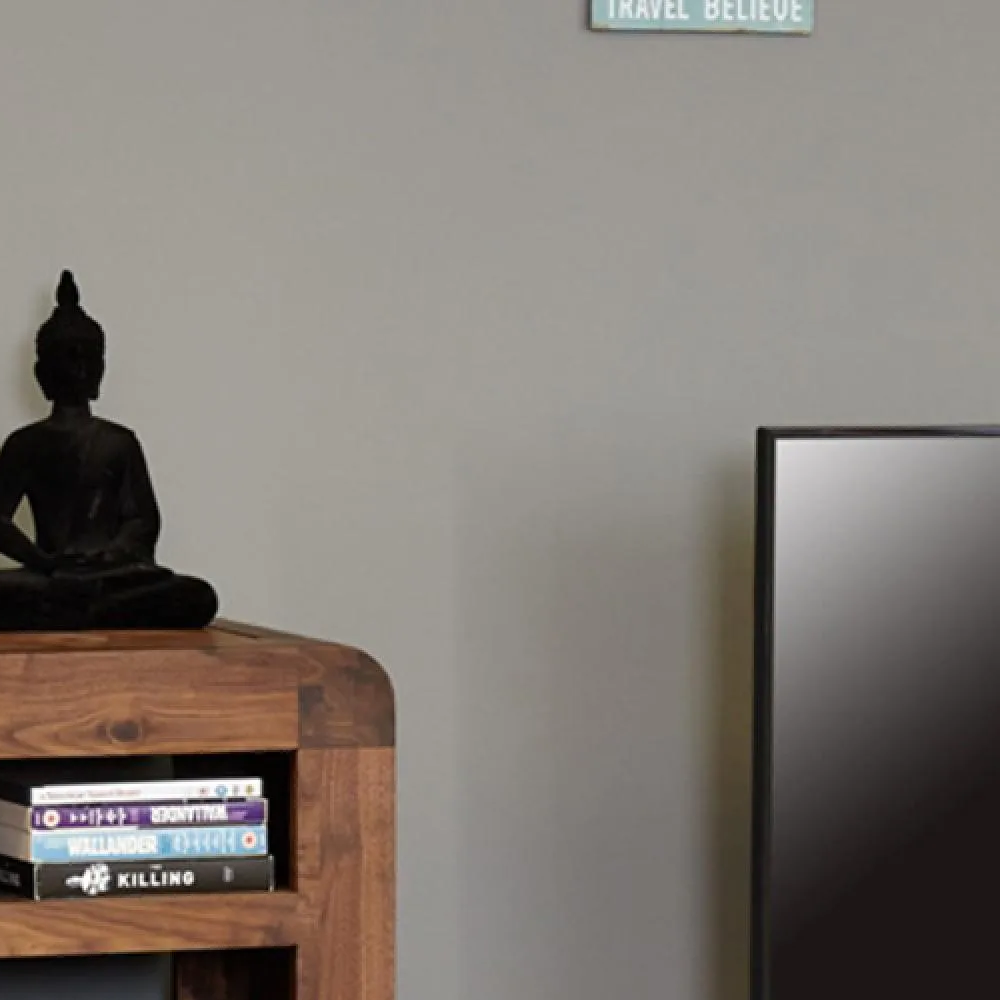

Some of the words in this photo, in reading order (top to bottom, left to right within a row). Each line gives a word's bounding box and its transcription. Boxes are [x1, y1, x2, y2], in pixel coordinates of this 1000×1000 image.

[607, 0, 690, 21] TRAVEL
[704, 0, 804, 22] BELIEVE
[67, 833, 159, 857] WALLANDER
[117, 869, 196, 890] KILLING
